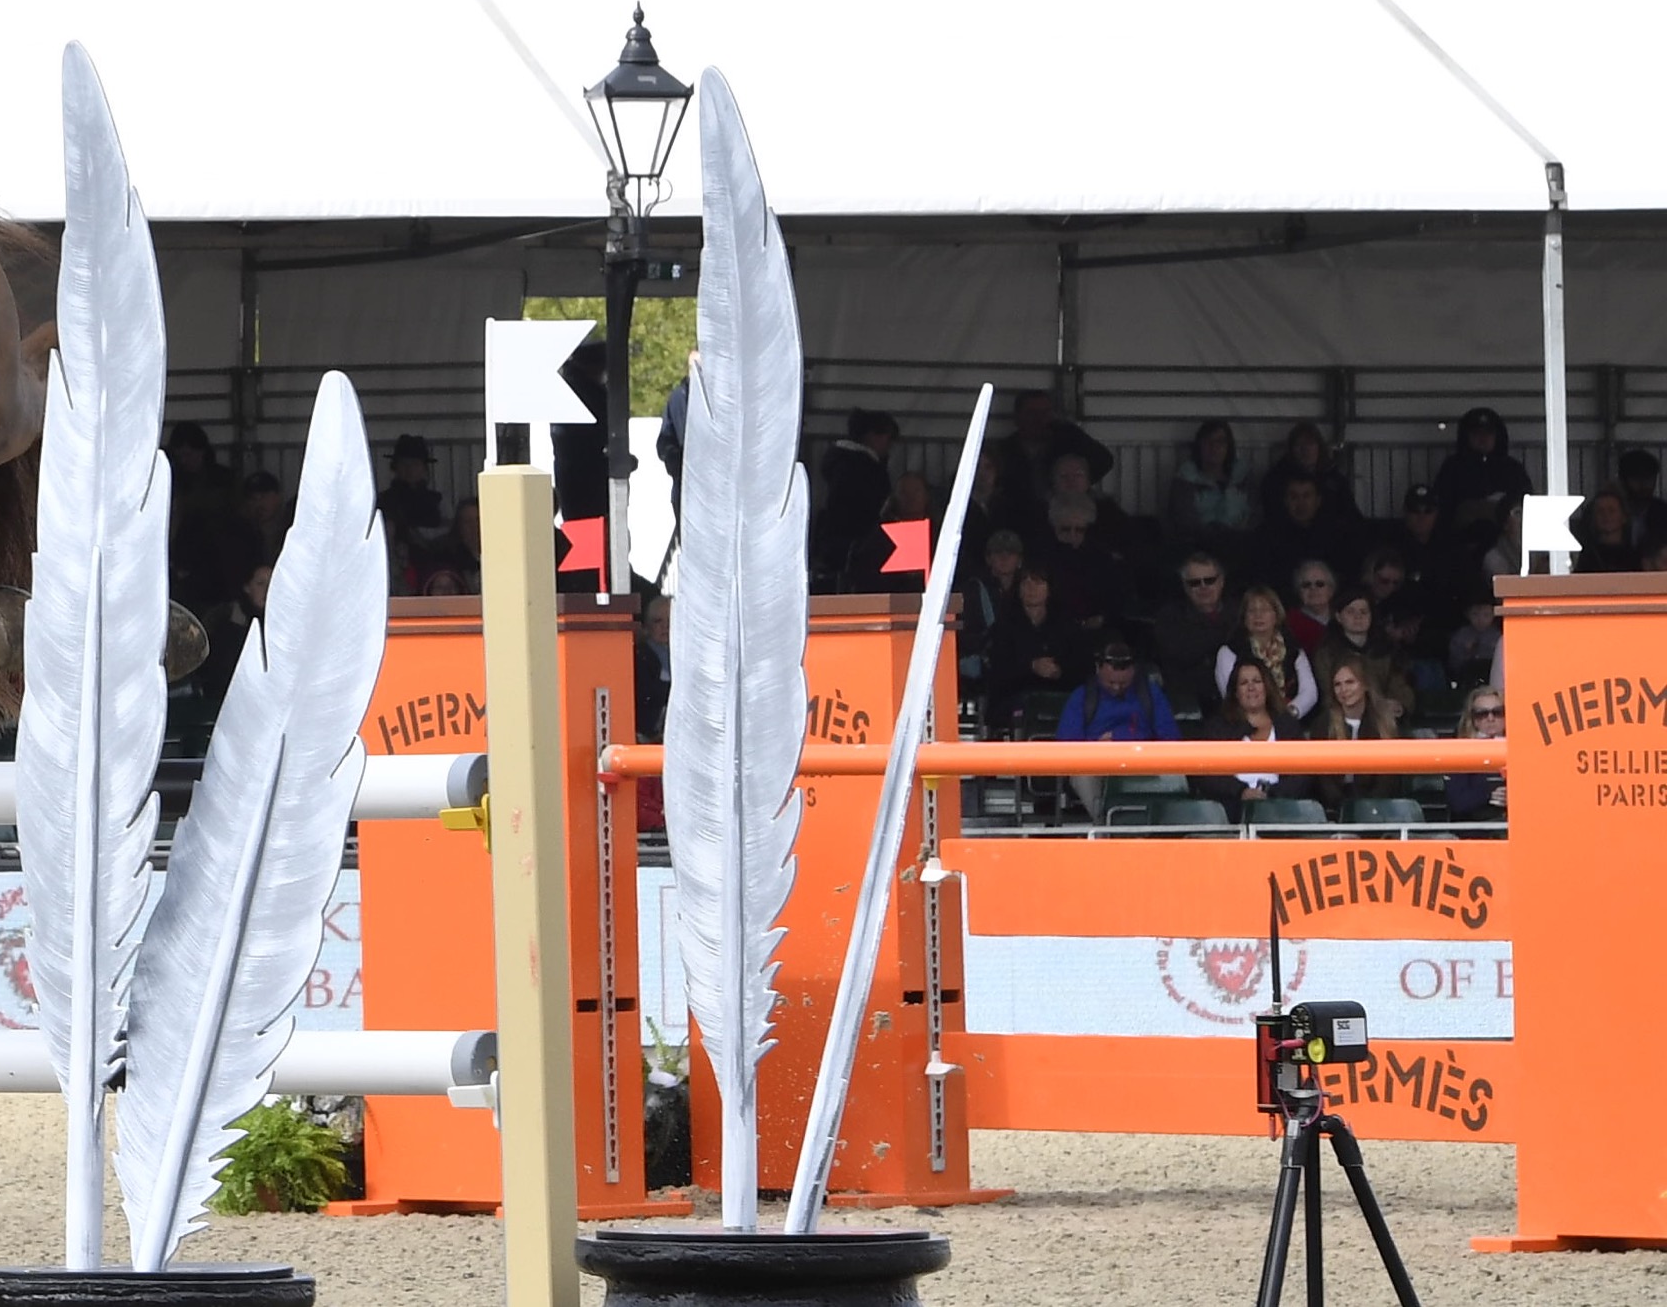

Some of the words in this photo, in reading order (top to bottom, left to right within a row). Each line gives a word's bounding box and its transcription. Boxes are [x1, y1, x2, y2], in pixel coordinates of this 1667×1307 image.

[378, 692, 486, 755] HERM
[1532, 677, 1667, 746] HERM
[1577, 750, 1667, 774] SELLIE
[1268, 847, 1493, 929] HERMÈS
[1399, 959, 1475, 999] OF
[1310, 1048, 1493, 1132] ERMÈS
